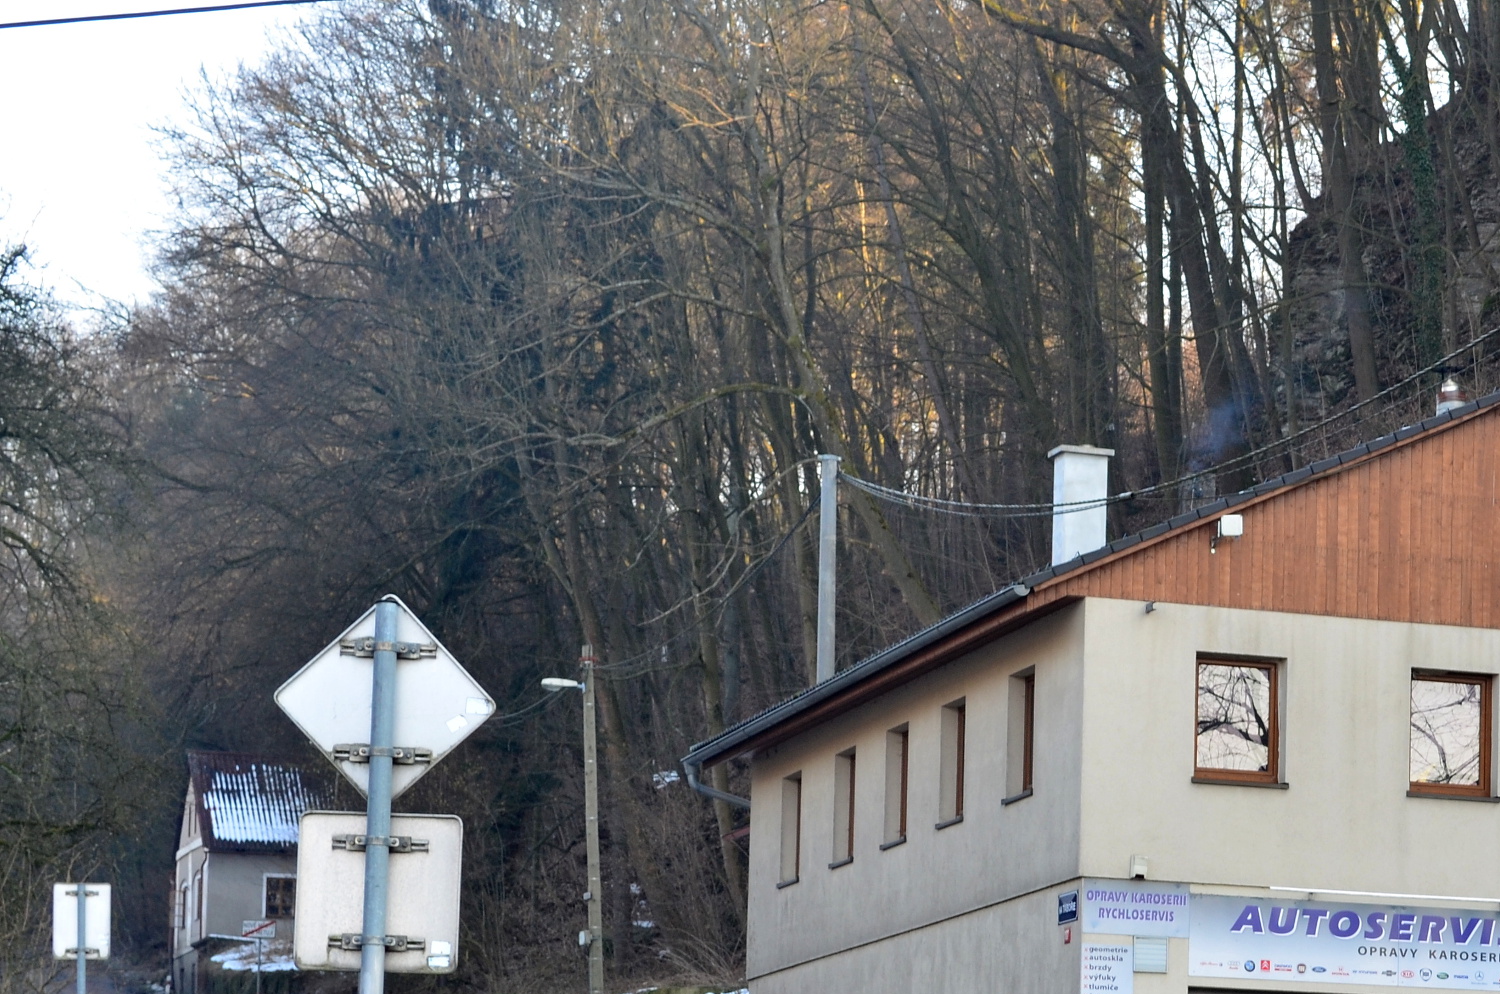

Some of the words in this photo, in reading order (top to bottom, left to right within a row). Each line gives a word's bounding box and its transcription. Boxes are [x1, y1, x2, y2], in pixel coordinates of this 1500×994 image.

[1086, 890, 1128, 902] OPRAVY
[1131, 892, 1188, 906] KAROSERIÍ
[1098, 907, 1174, 921] RYCHLOSERVIS
[1357, 945, 1419, 959] OPRAVY
[1089, 964, 1112, 972] brzdy
[1088, 974, 1116, 982] výfuky
[1088, 983, 1119, 991] tlumiče
